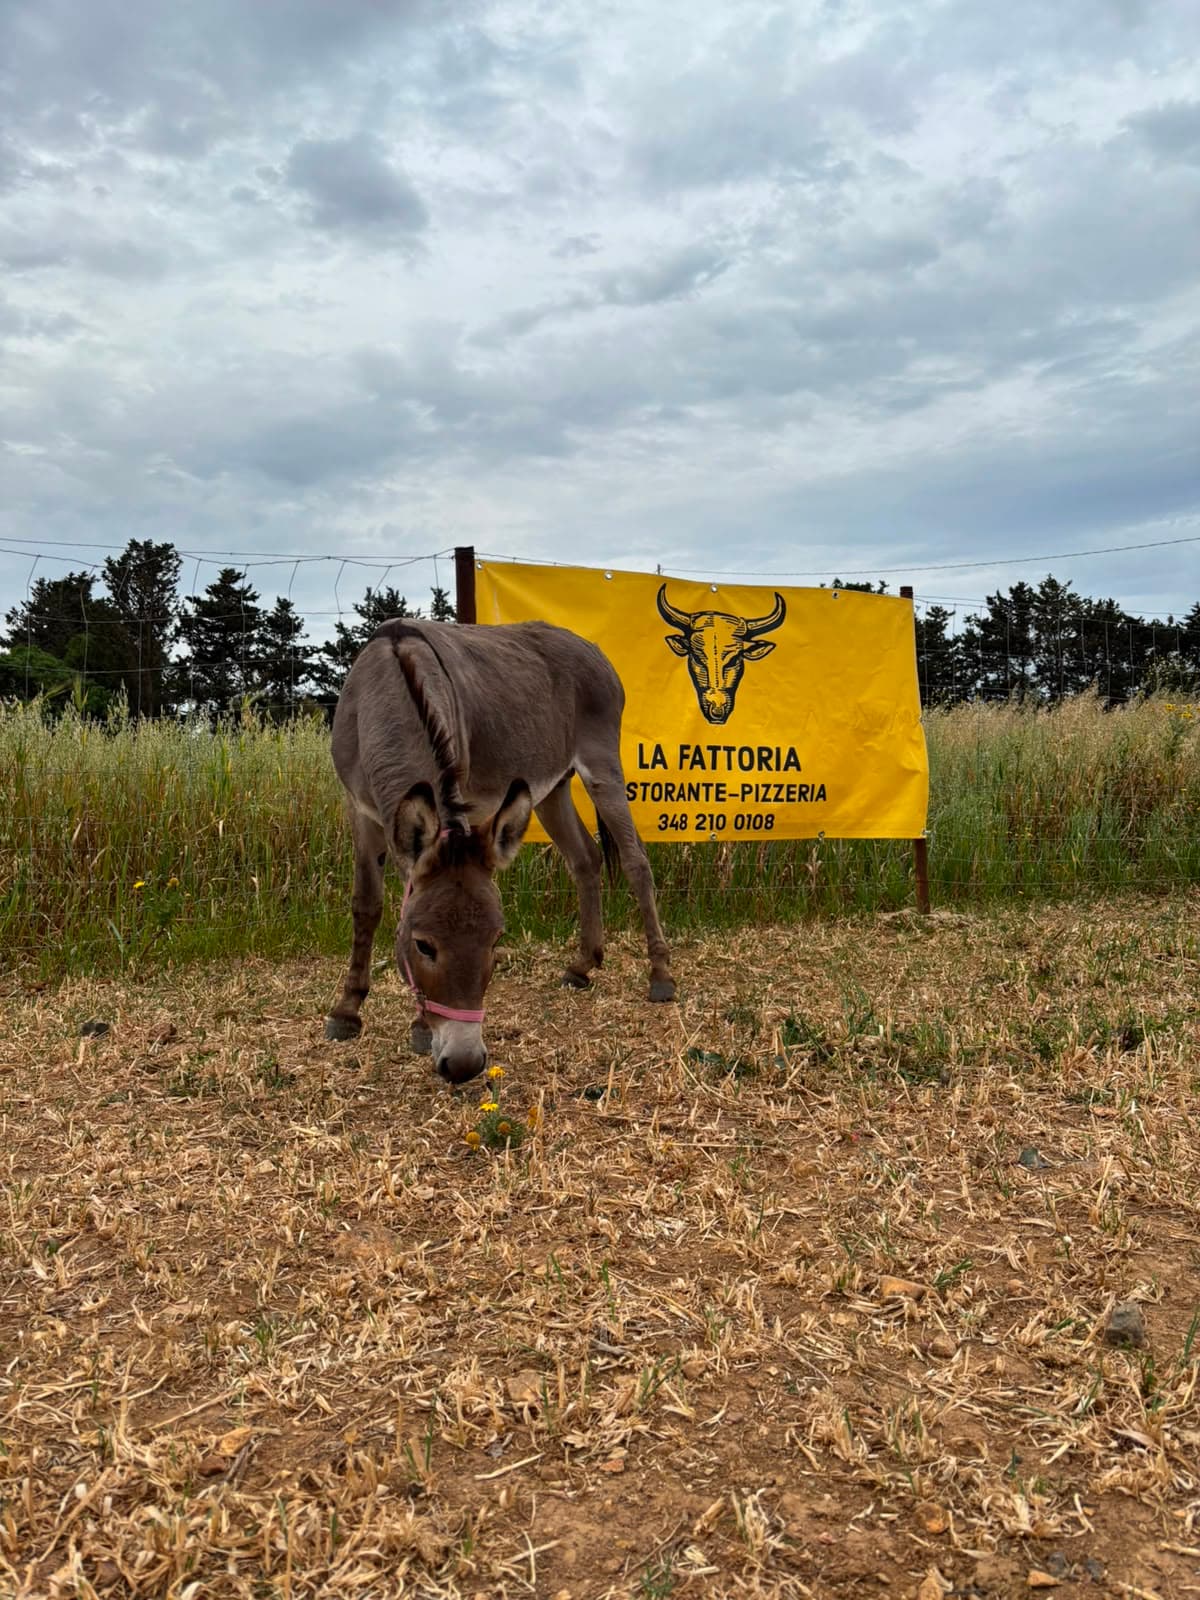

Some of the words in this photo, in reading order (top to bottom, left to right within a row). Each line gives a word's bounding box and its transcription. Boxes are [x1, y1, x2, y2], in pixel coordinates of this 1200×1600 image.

[638, 743, 668, 770] LA
[679, 745, 802, 772] FATTORIA
[626, 782, 827, 802] STORANTE-PIZZERIA
[658, 813, 688, 831] 348
[695, 813, 726, 831] 210
[734, 813, 775, 831] 0108
